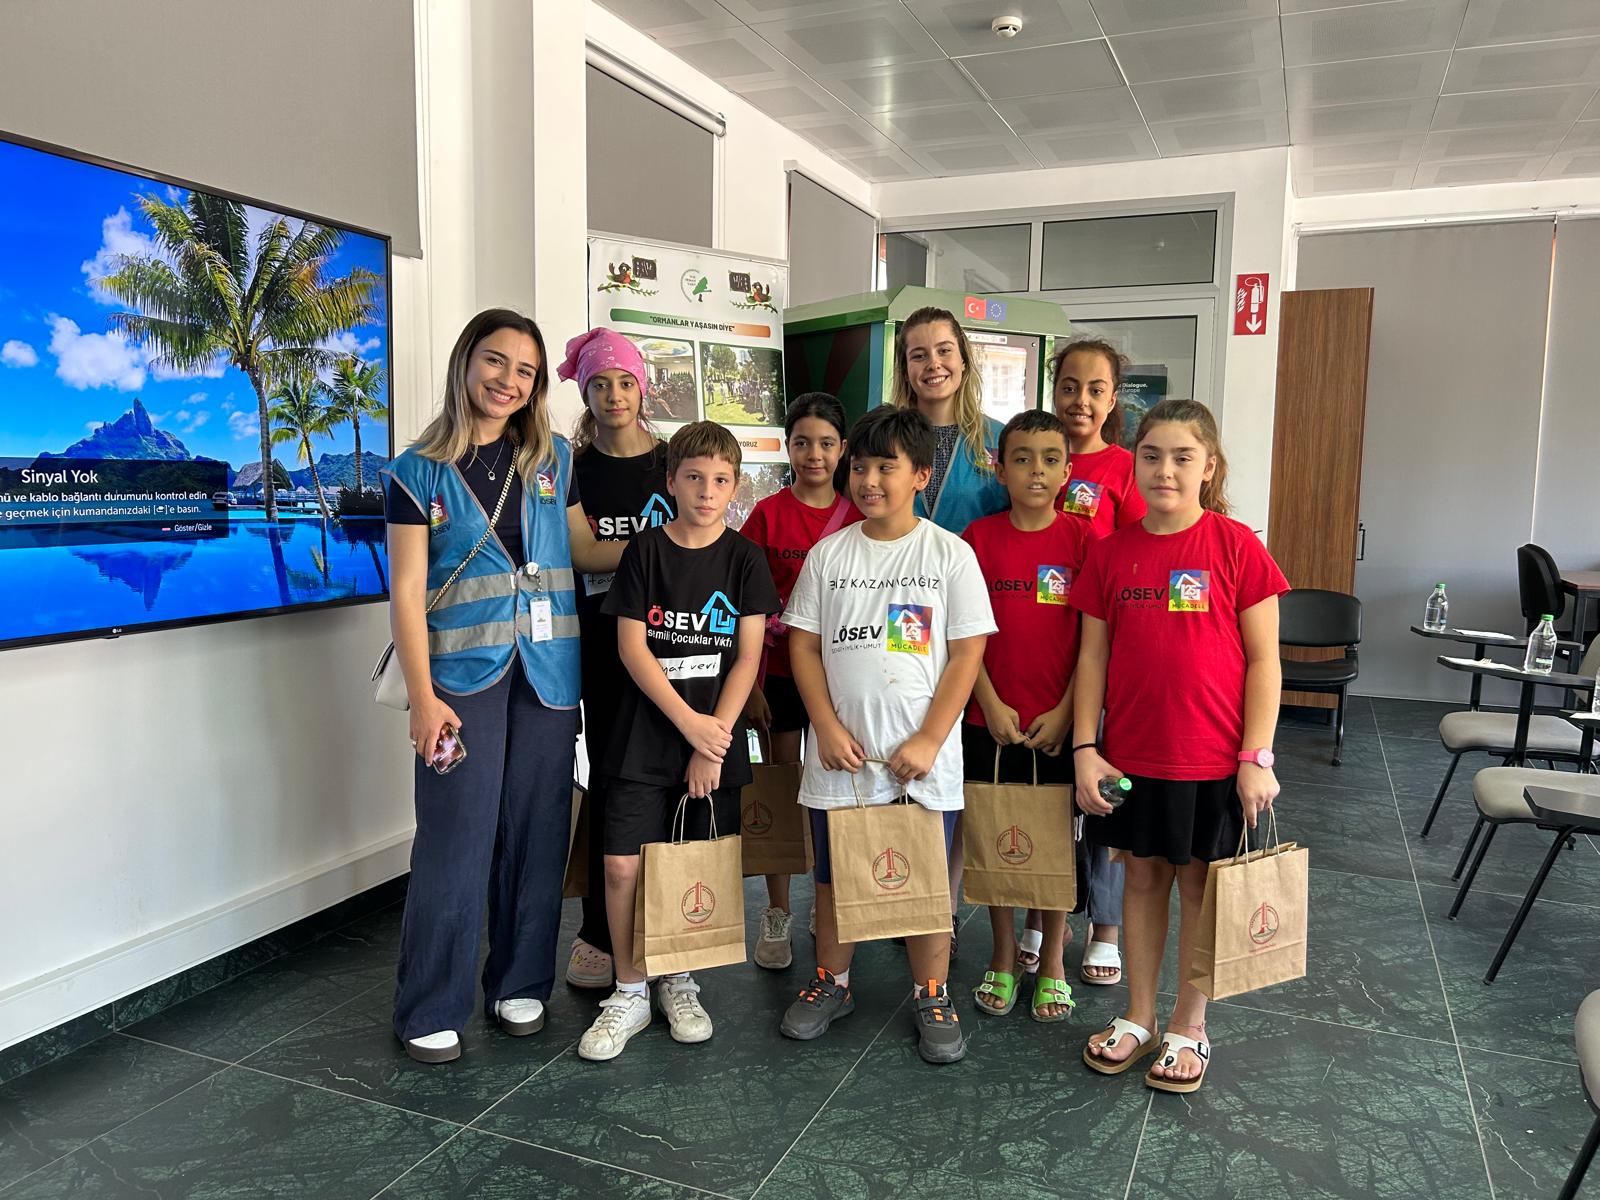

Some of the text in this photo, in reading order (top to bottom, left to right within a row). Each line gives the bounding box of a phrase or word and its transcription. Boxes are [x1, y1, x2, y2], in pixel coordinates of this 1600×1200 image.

[690, 320, 718, 330] YAŞASIN
[21, 469, 98, 487] Sinyal Yok
[13, 494, 27, 502] ve
[29, 492, 59, 502] kablo
[61, 491, 102, 504] bağlantı
[103, 491, 153, 501] durumunu
[155, 490, 187, 500] kontrol
[188, 490, 207, 500] edin
[5, 507, 50, 521] geçmek
[51, 506, 71, 519] için
[73, 504, 151, 517] kumandanızdaki
[177, 504, 201, 514] basın.
[174, 522, 213, 532] Göster/Gizle
[1115, 586, 1166, 602] LÖSEV
[671, 631, 713, 645] Çocuklar
[832, 624, 882, 644] LÖSEV
